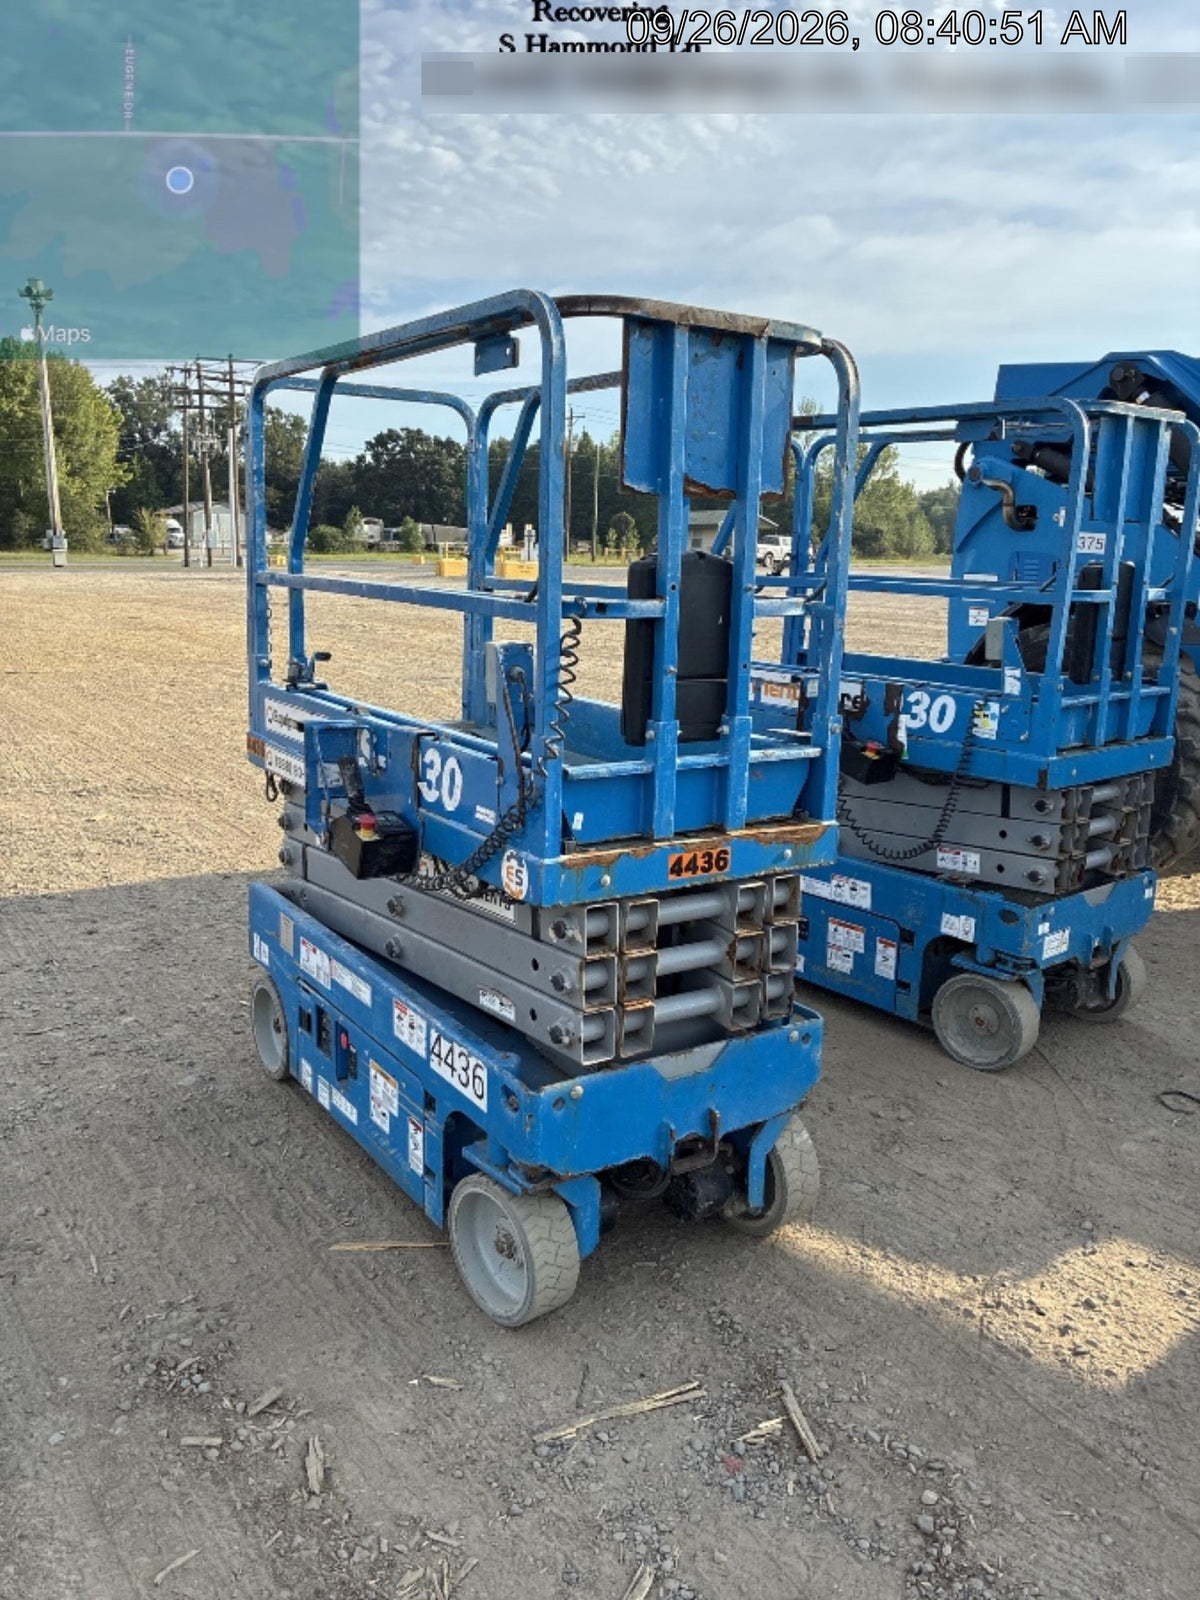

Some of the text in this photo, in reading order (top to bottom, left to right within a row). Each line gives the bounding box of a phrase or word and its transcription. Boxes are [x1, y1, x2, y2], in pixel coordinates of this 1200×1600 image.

[905, 690, 957, 734] 30
[417, 747, 464, 812] 30
[669, 848, 730, 877] 4436
[431, 1033, 485, 1101] 4436
